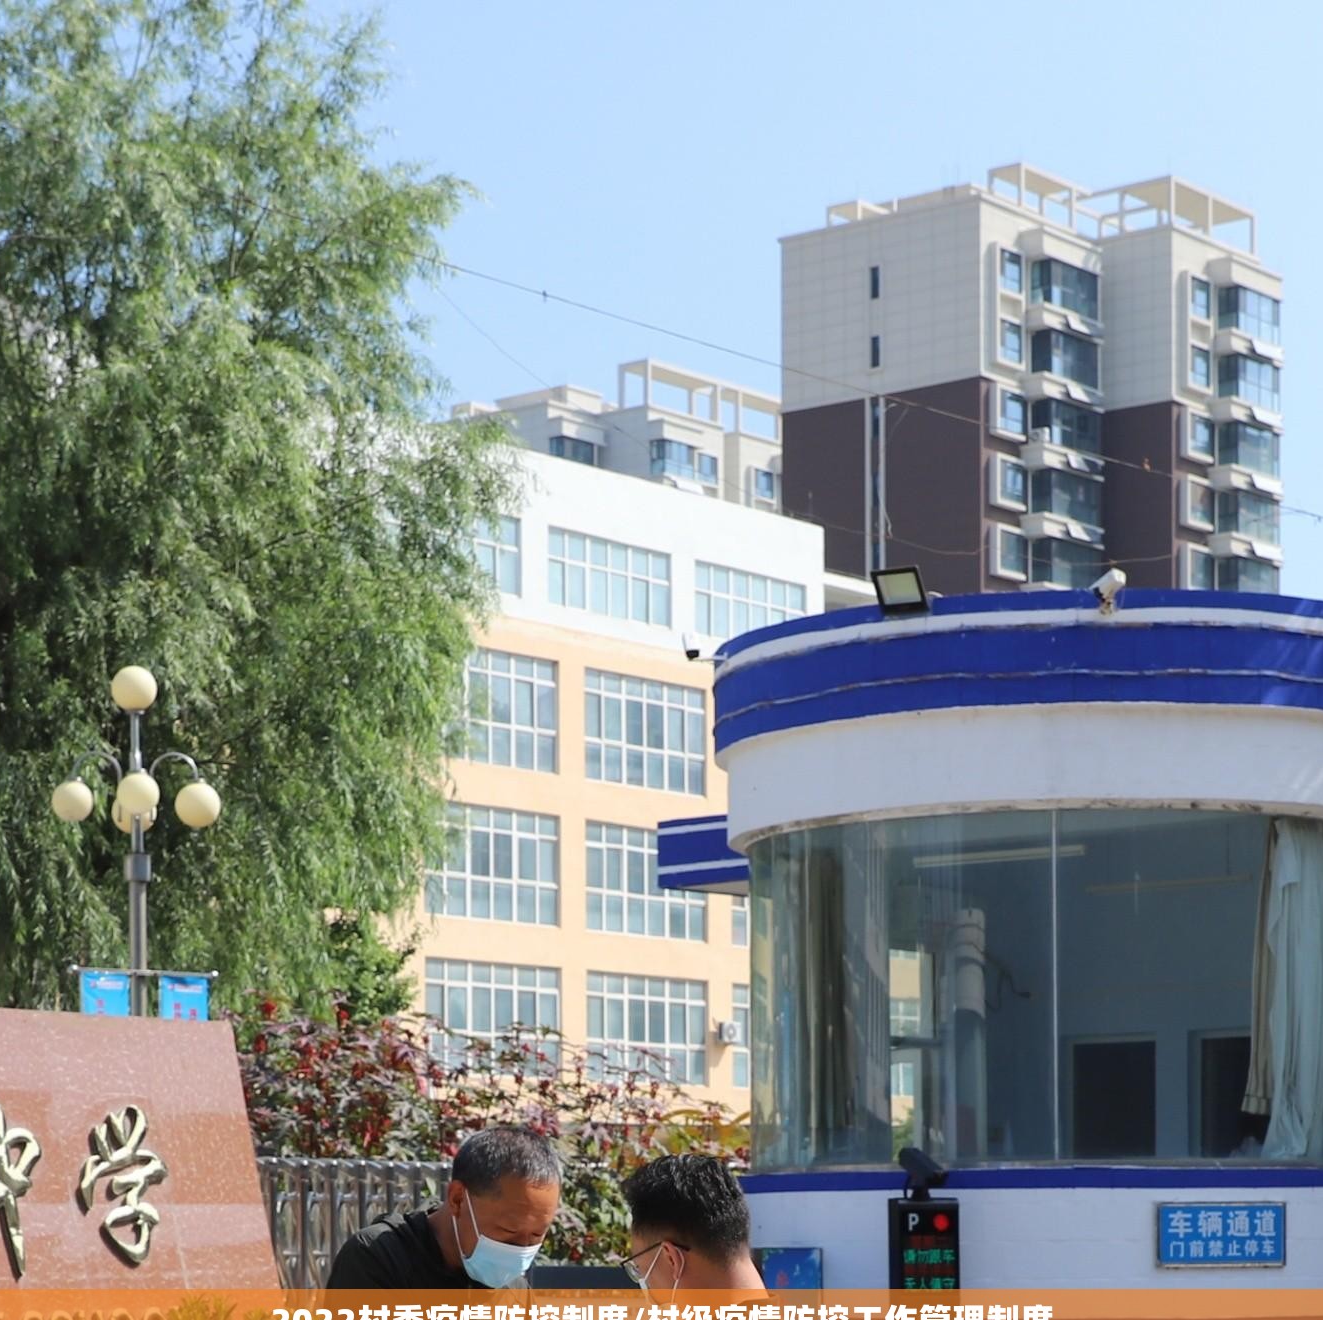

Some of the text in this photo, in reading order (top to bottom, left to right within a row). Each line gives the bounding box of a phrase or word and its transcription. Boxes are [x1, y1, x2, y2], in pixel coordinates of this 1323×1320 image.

[908, 1212, 919, 1231] P
[1168, 1210, 1276, 1238] 车辆通道
[1169, 1239, 1275, 1257] 门前禁止停车
